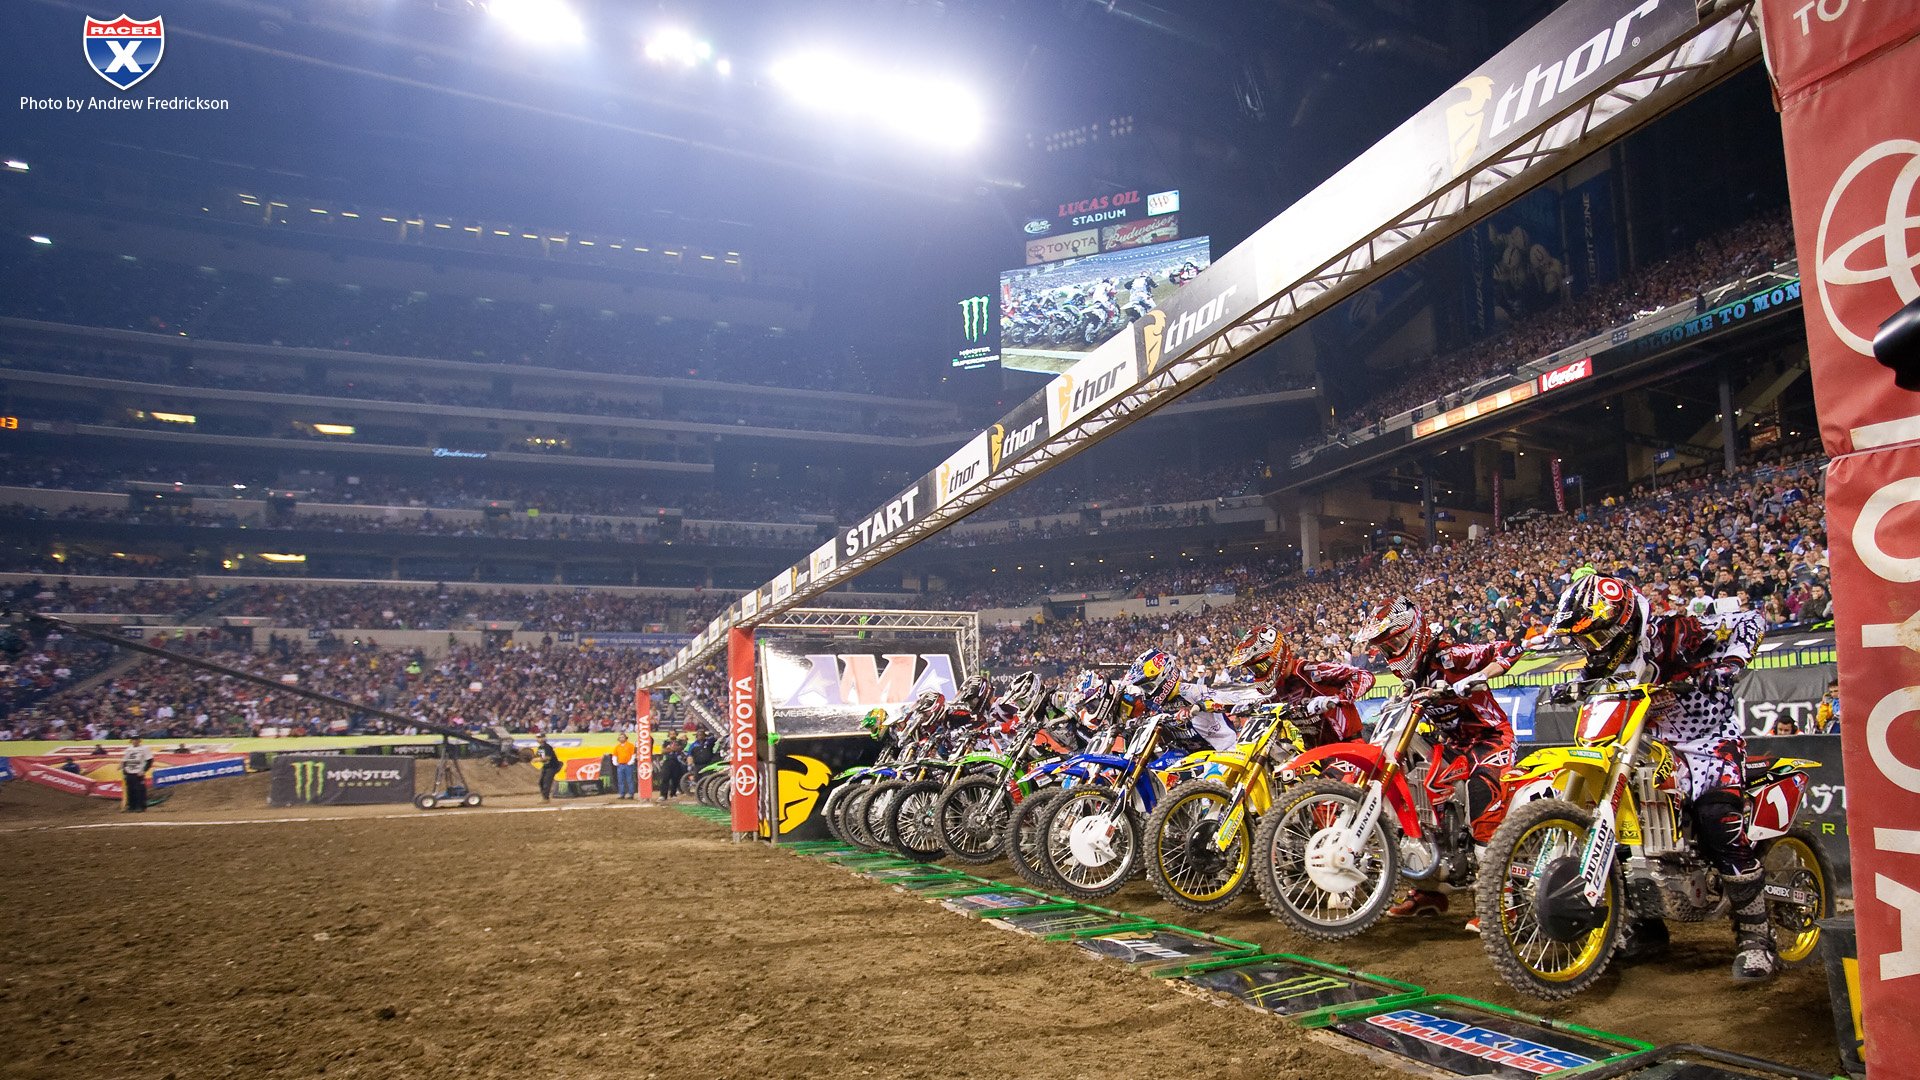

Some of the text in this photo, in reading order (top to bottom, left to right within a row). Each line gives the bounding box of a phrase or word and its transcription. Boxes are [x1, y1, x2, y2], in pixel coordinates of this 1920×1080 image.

[1489, 0, 1660, 138] thor
[1058, 190, 1140, 217] LUCAS OIL
[1072, 209, 1127, 226] STADIUM
[1045, 236, 1097, 254] TOYOTA
[1105, 214, 1178, 250] Budweiser
[1163, 284, 1238, 353] thor
[1719, 303, 1746, 324] TO
[1072, 361, 1127, 413] thor
[1002, 417, 1043, 459] thor
[949, 459, 980, 494] thor
[845, 486, 919, 557] START
[639, 715, 649, 761] TOYOTA
[736, 676, 754, 762] TOYOTA
[1583, 700, 1621, 740] 1
[157, 764, 244, 784] AIRFORCE.COM
[326, 769, 401, 781] MONSTER
[1355, 796, 1378, 839] DUNLOP
[1766, 784, 1790, 829] 1
[1584, 818, 1608, 884] DUNLOP
[1366, 1014, 1566, 1075] UNLIMITED
[1384, 1009, 1597, 1068] PARTS
